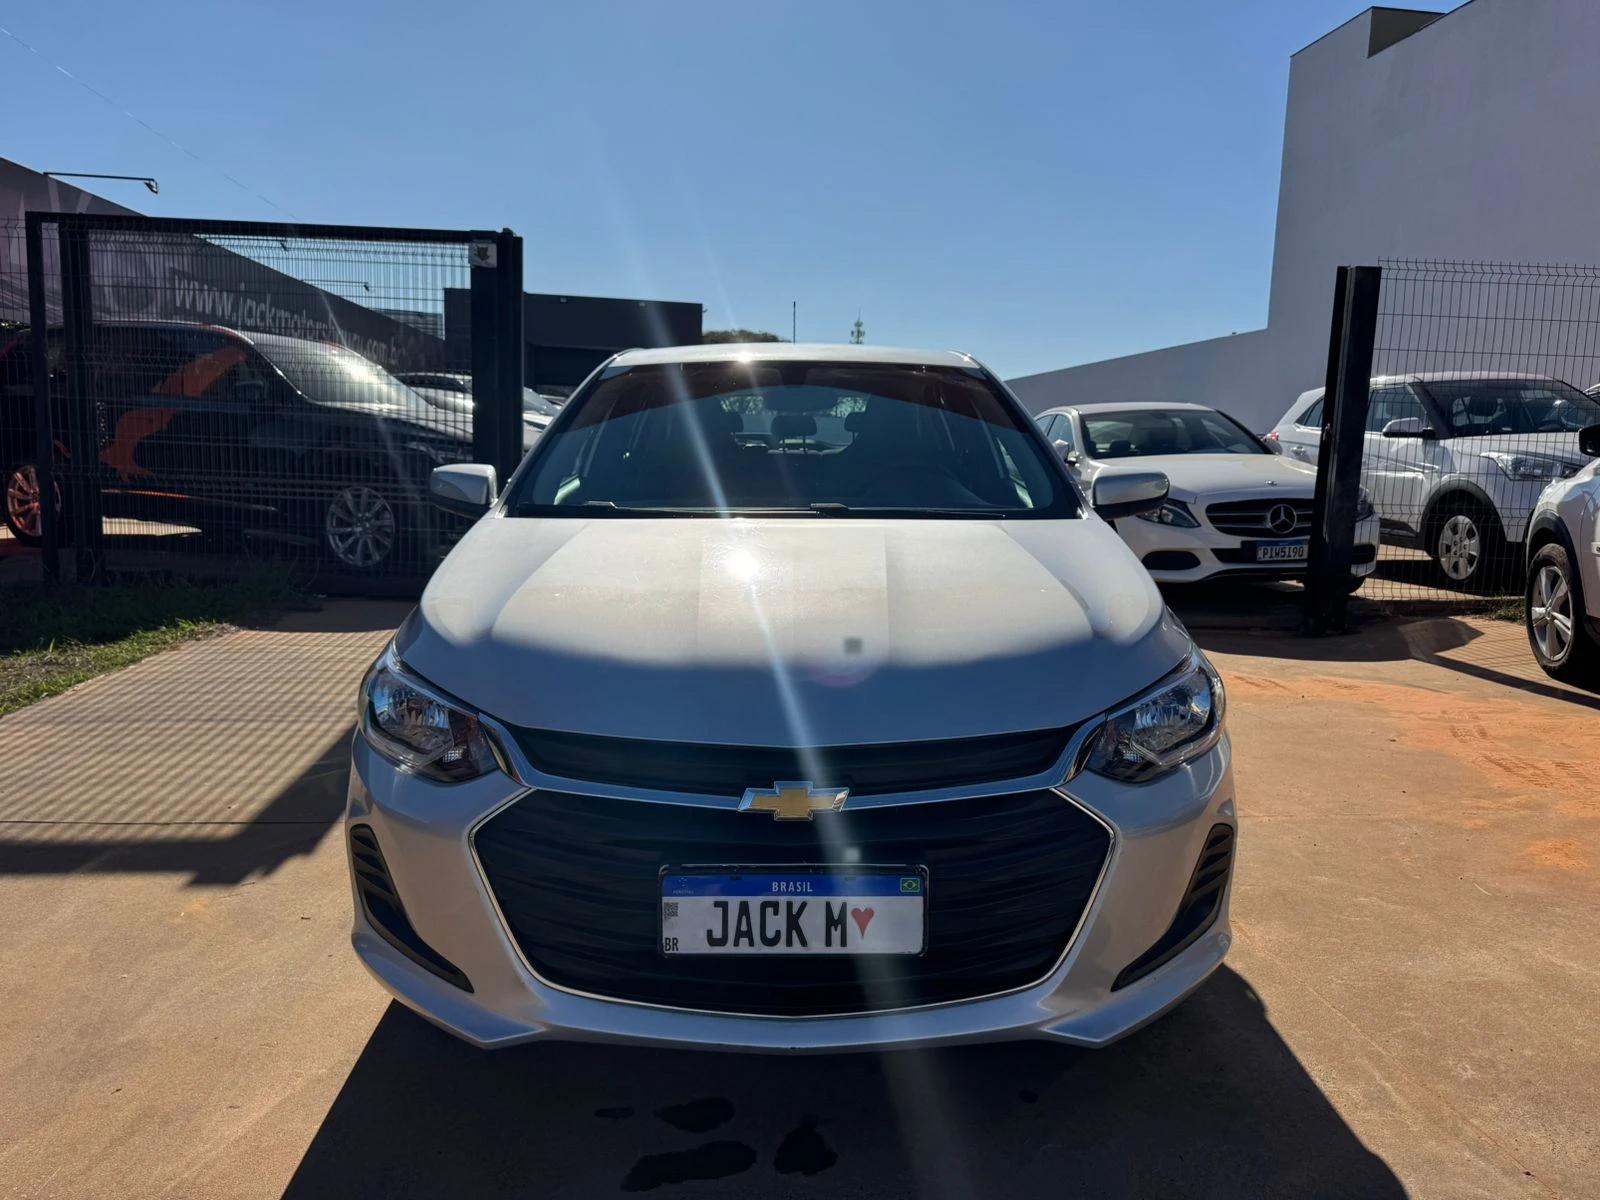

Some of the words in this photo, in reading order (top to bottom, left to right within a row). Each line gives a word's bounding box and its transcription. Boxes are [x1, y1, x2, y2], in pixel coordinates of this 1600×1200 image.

[772, 881, 813, 892] BRASIL
[706, 900, 808, 947] JACK
[825, 901, 847, 947] M
[664, 937, 679, 951] BR
